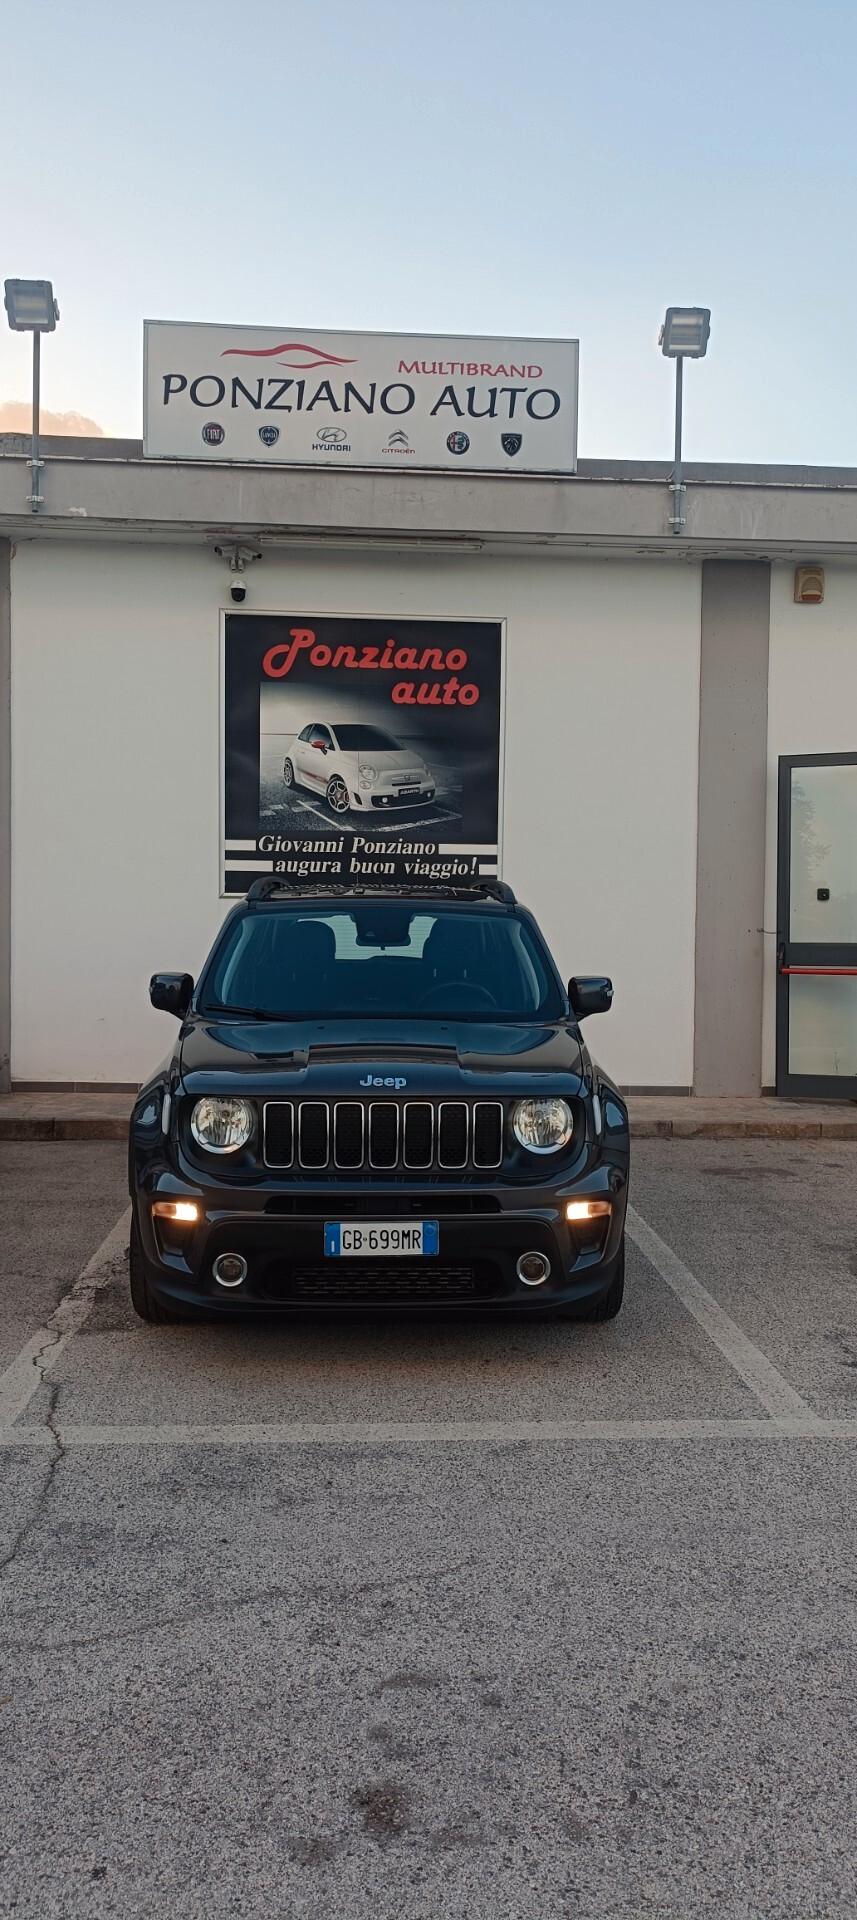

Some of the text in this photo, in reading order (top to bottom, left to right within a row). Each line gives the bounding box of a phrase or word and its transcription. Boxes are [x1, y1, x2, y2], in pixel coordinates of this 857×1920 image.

[398, 360, 543, 379] MULTIBRAND
[162, 373, 561, 420] PONZIANO AUTO
[312, 443, 351, 452] HYUNDAI
[262, 628, 468, 678] Ponziano
[391, 676, 480, 706] auto
[258, 835, 436, 855] Giovanni Ponziano
[275, 856, 478, 879] augura buon viaggio!
[359, 1074, 407, 1090] Jeep
